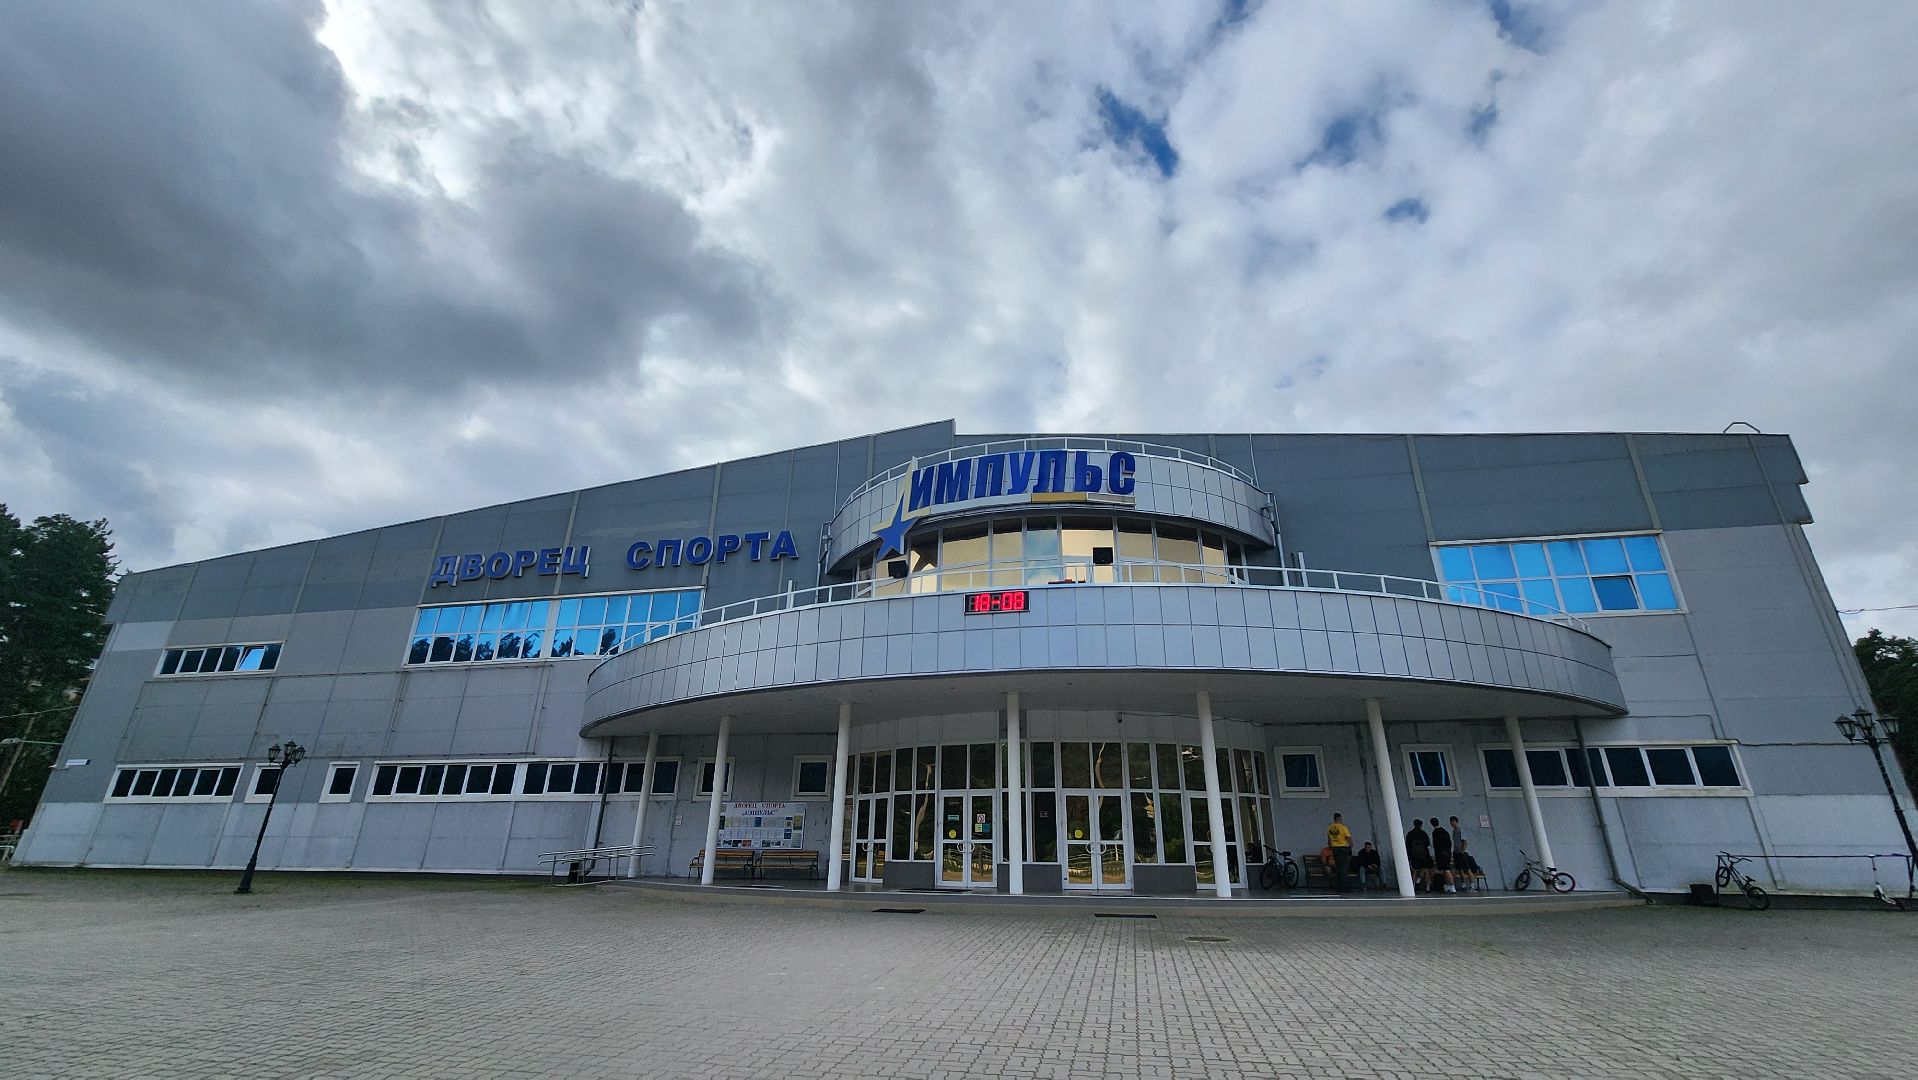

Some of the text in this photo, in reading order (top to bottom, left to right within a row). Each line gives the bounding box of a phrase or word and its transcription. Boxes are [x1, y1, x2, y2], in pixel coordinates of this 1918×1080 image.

[908, 449, 1136, 512] ИМПУЛЬС
[430, 530, 799, 588] ДВОРЕЦ СПОРТА
